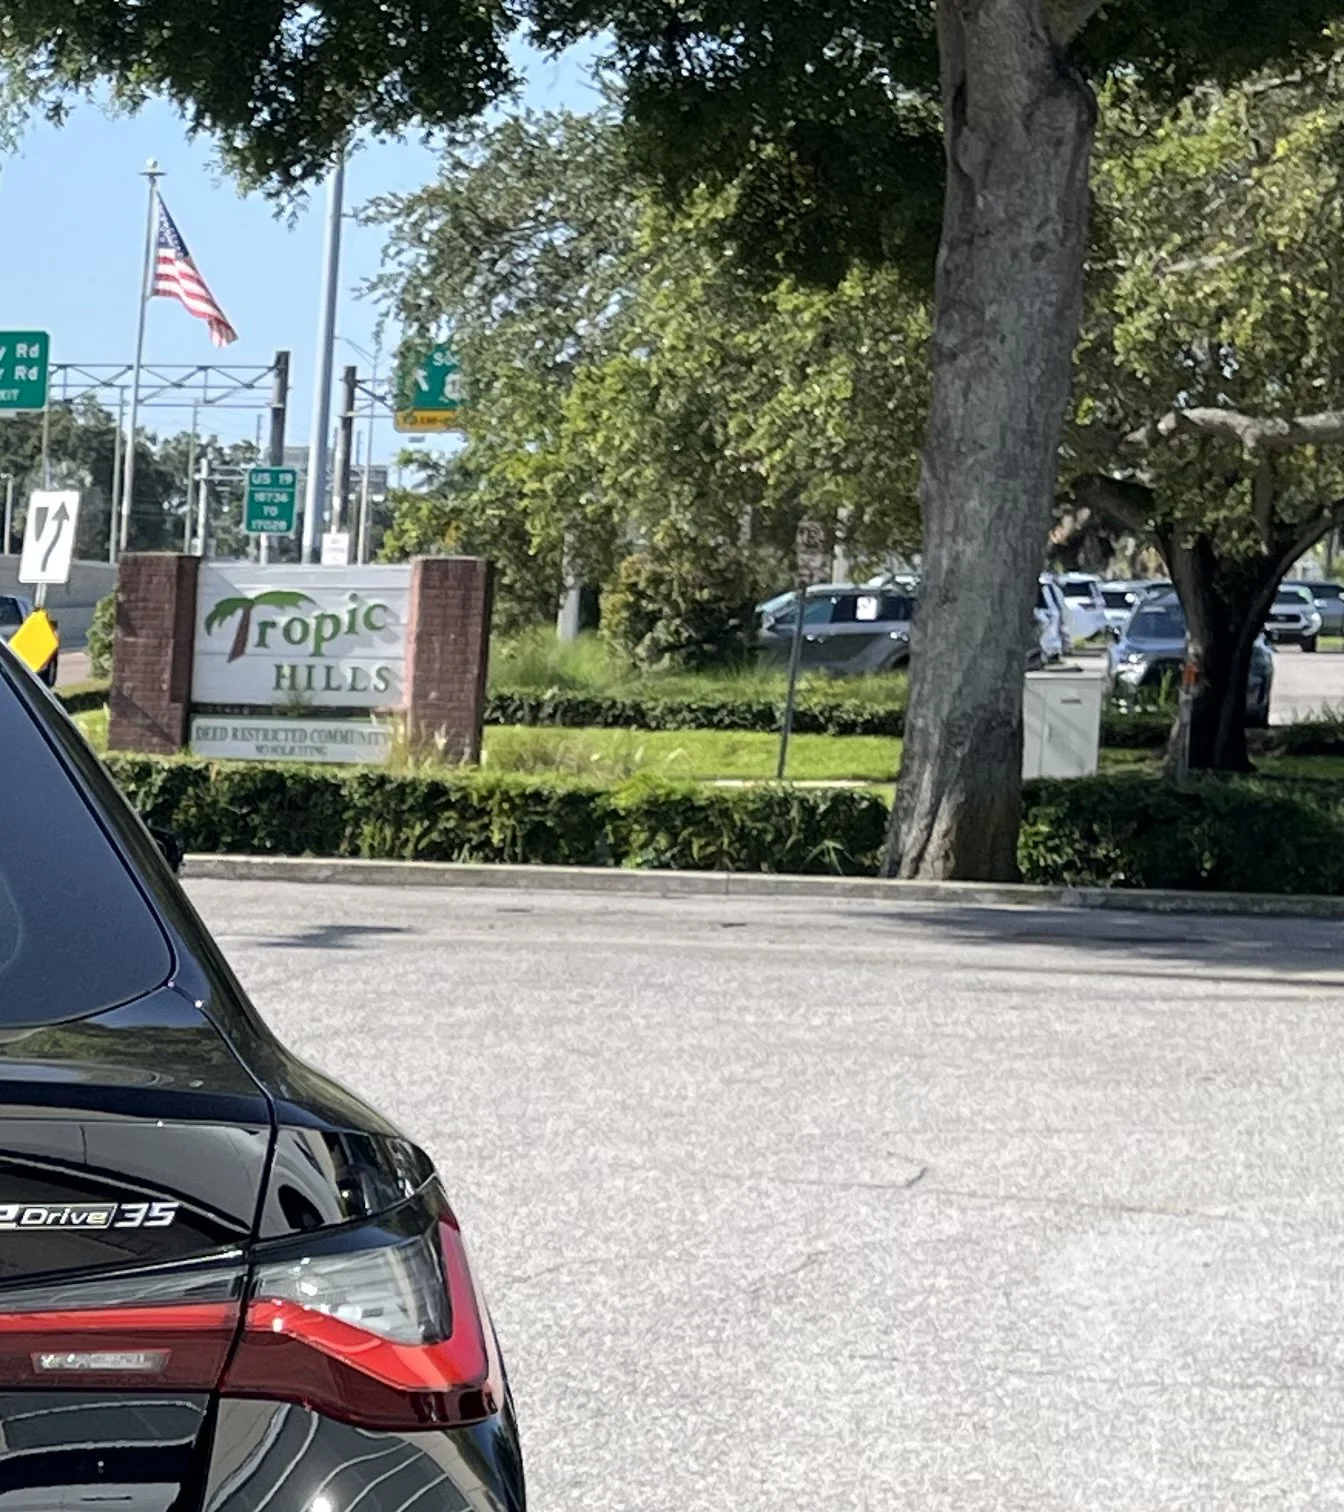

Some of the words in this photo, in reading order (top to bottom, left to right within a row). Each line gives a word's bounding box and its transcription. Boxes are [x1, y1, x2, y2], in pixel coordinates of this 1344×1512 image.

[15, 342, 40, 358] Rd
[14, 365, 40, 380] Rd
[252, 472, 272, 485] US
[278, 472, 294, 485] 19
[263, 505, 278, 517] TO
[204, 590, 390, 663] Tropic
[272, 663, 391, 693] HILLS
[195, 726, 228, 742] DEED
[231, 726, 308, 743] RESTRICTED
[310, 727, 388, 746] COMMUNITY
